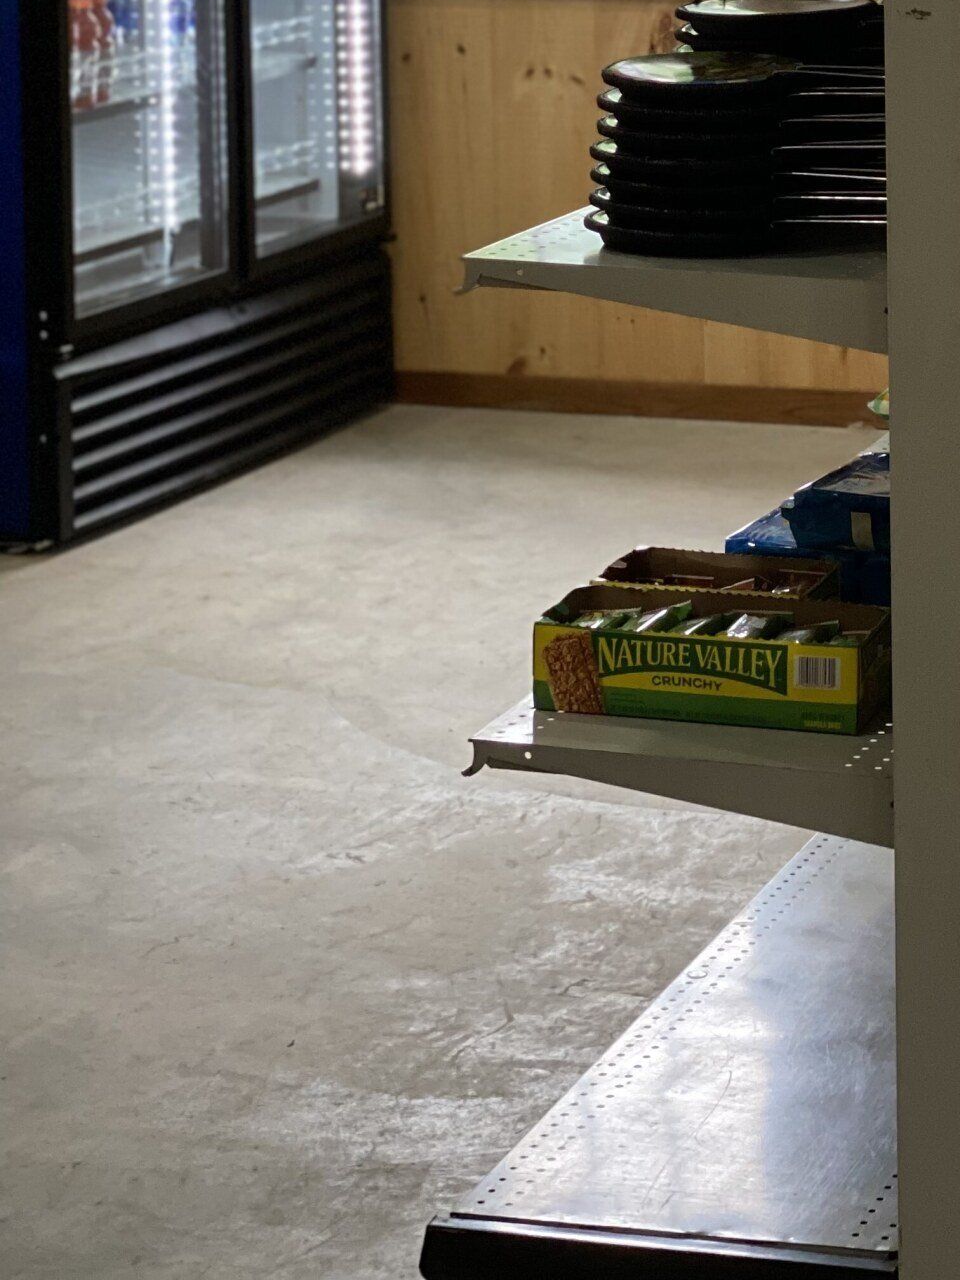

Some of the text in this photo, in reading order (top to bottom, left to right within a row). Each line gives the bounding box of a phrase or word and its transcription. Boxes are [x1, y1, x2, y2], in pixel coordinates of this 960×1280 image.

[599, 637, 783, 689] NATURE VALLEY
[652, 675, 723, 691] CRUNCHY
